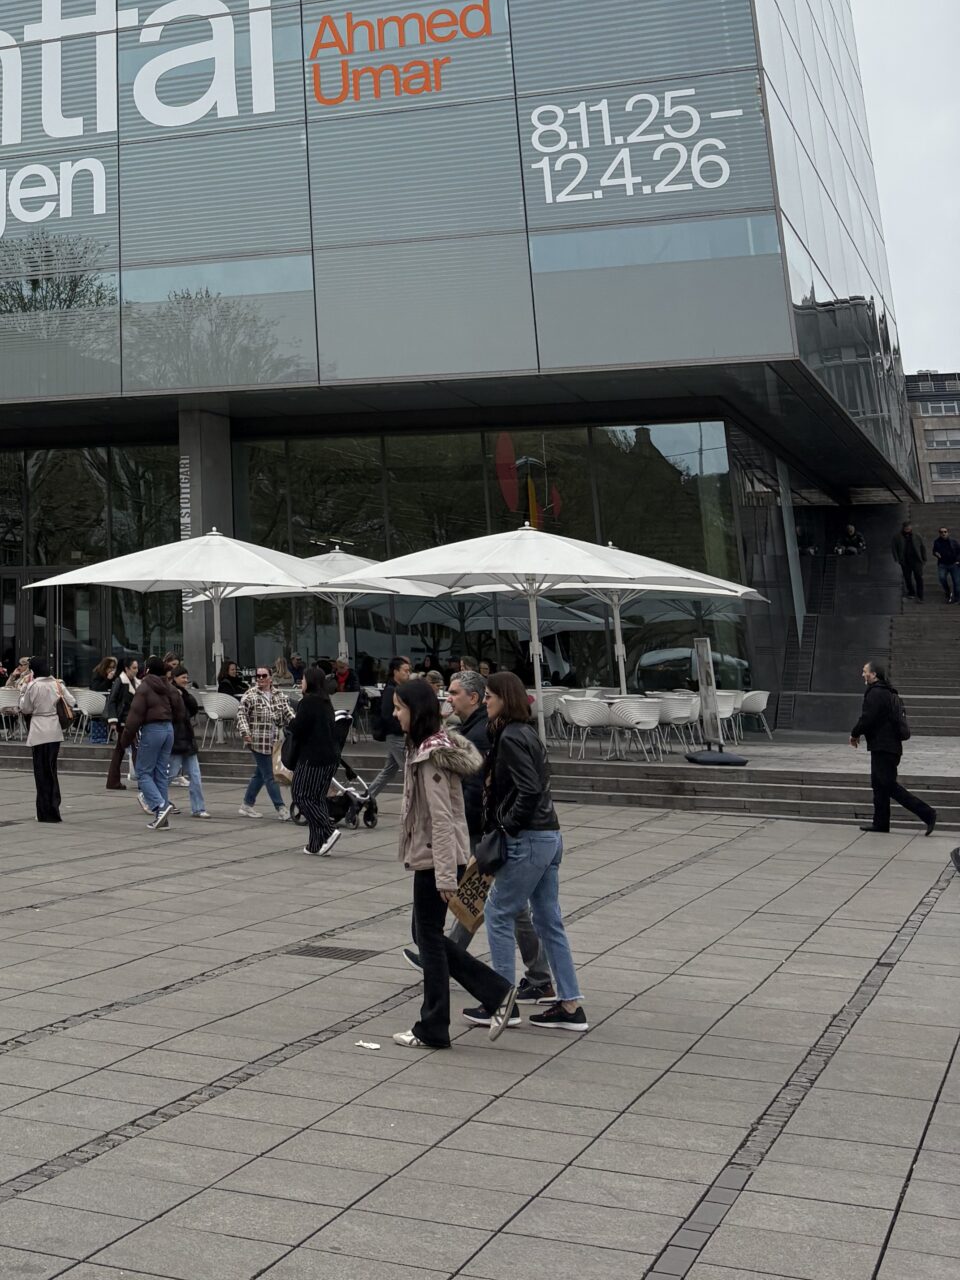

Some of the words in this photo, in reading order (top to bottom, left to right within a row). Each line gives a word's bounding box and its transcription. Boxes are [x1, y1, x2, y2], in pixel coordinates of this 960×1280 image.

[313, 57, 451, 106] Umar
[531, 138, 730, 203] 12.4.26
[179, 455, 191, 518] STUTTGART
[456, 888, 480, 918] MORE
[460, 882, 478, 903] FOR
[465, 877, 486, 900] MAD
